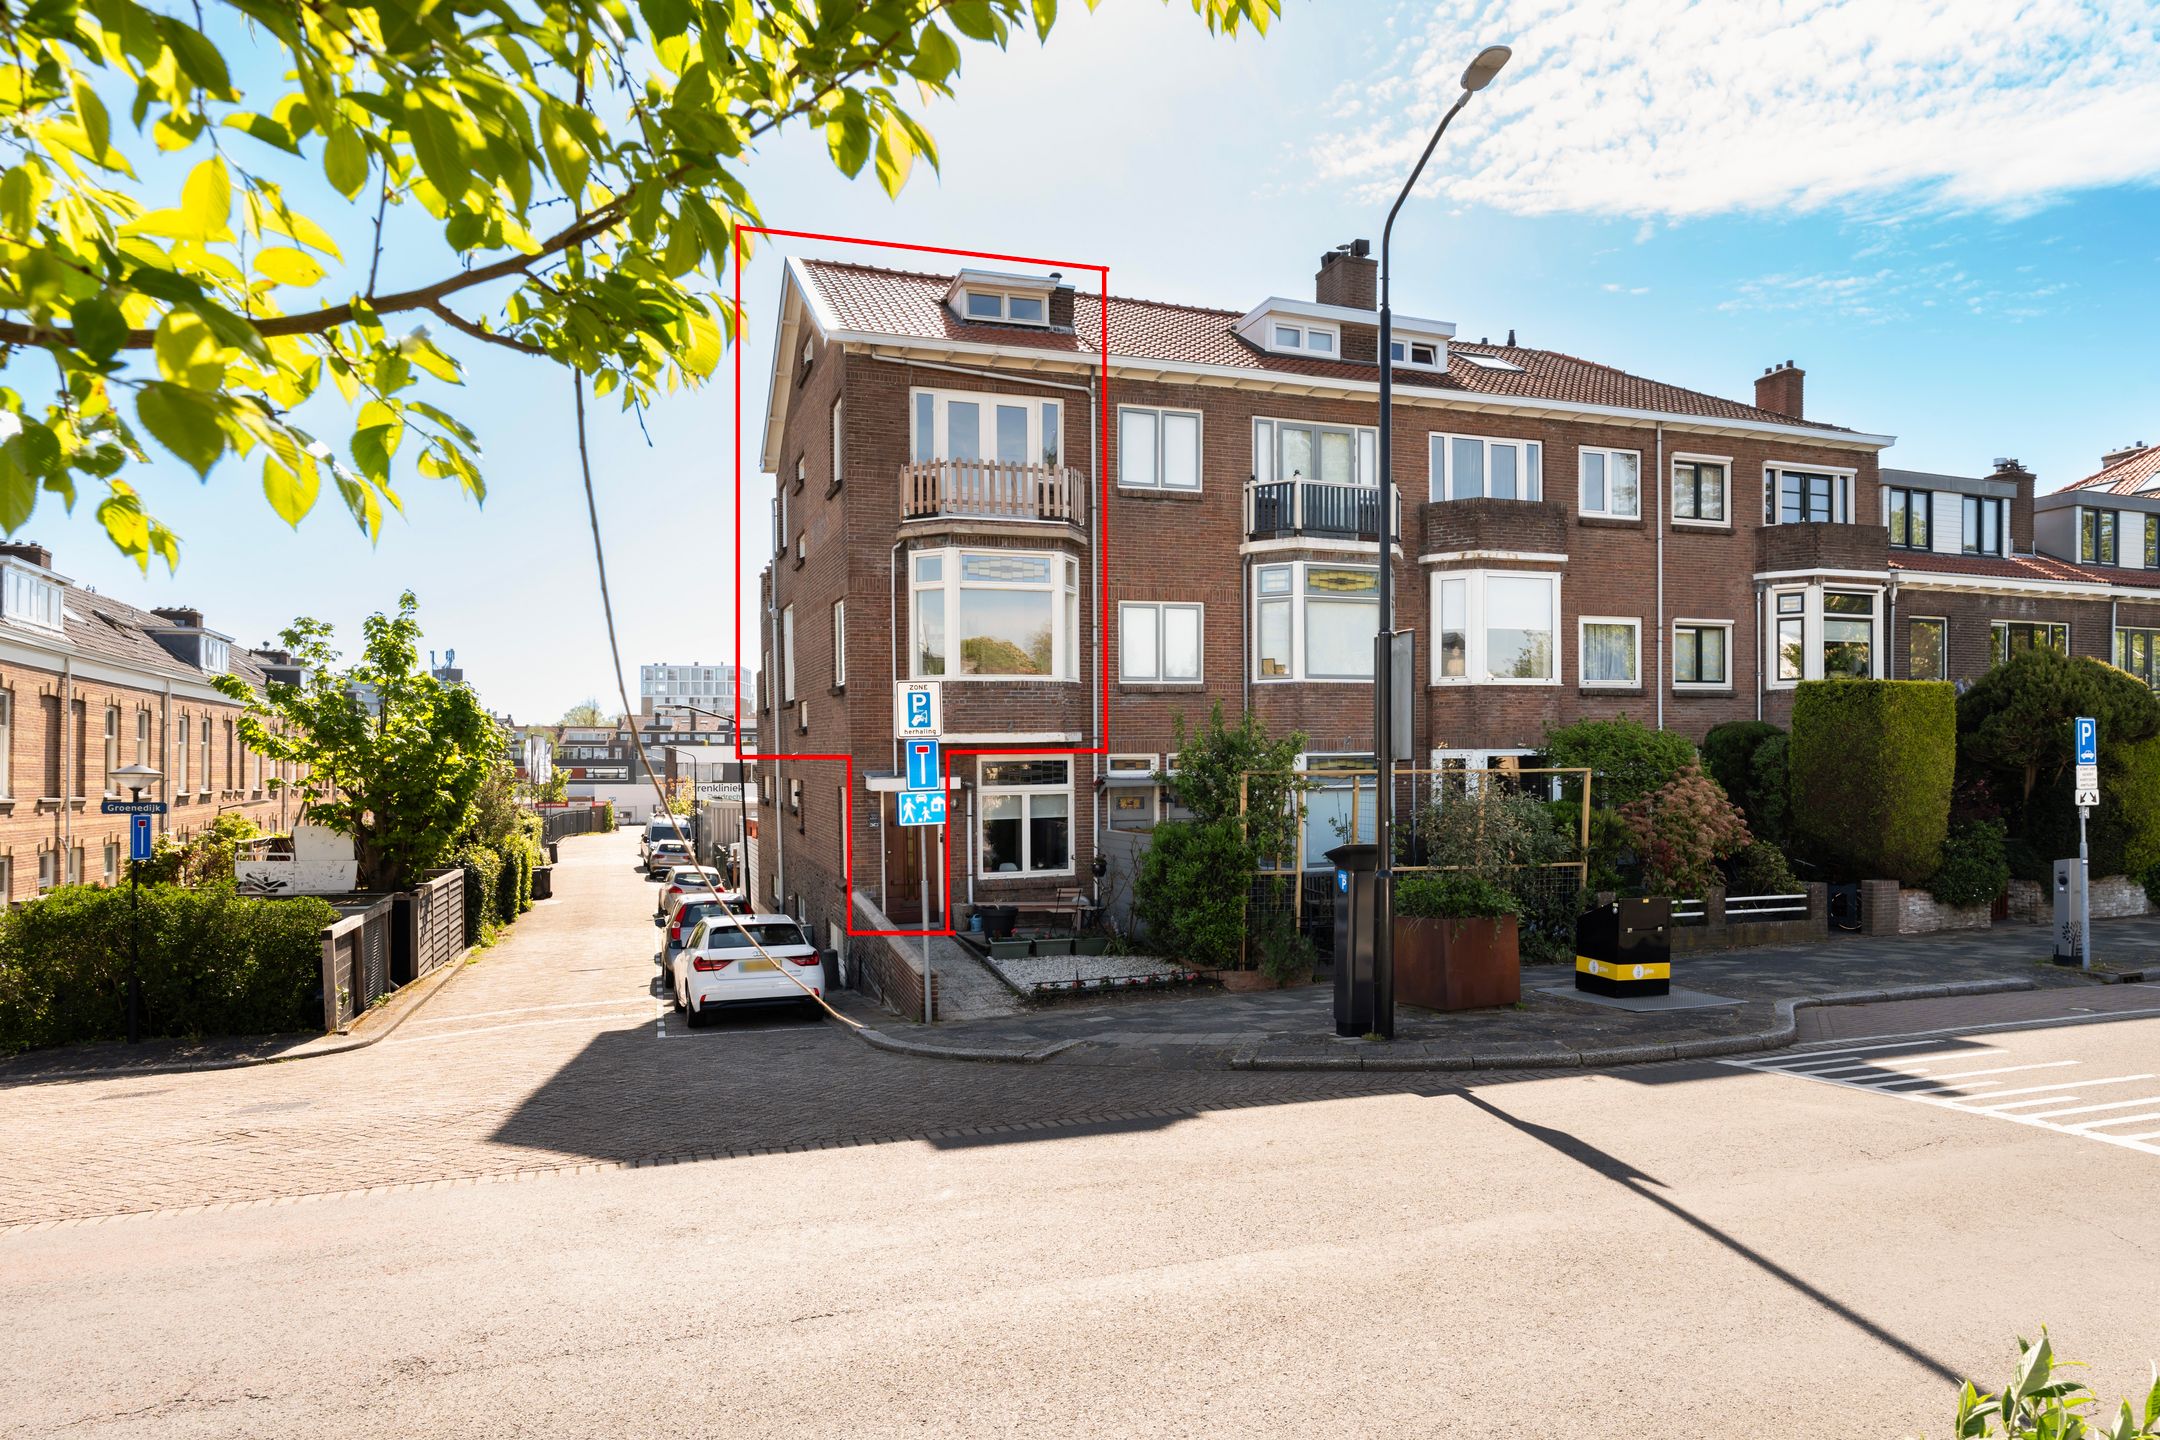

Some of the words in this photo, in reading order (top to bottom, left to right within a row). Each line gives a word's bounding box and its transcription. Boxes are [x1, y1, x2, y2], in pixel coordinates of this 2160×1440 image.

[912, 694, 927, 714] P
[2082, 722, 2092, 746] P
[107, 804, 161, 812] Groenedijk
